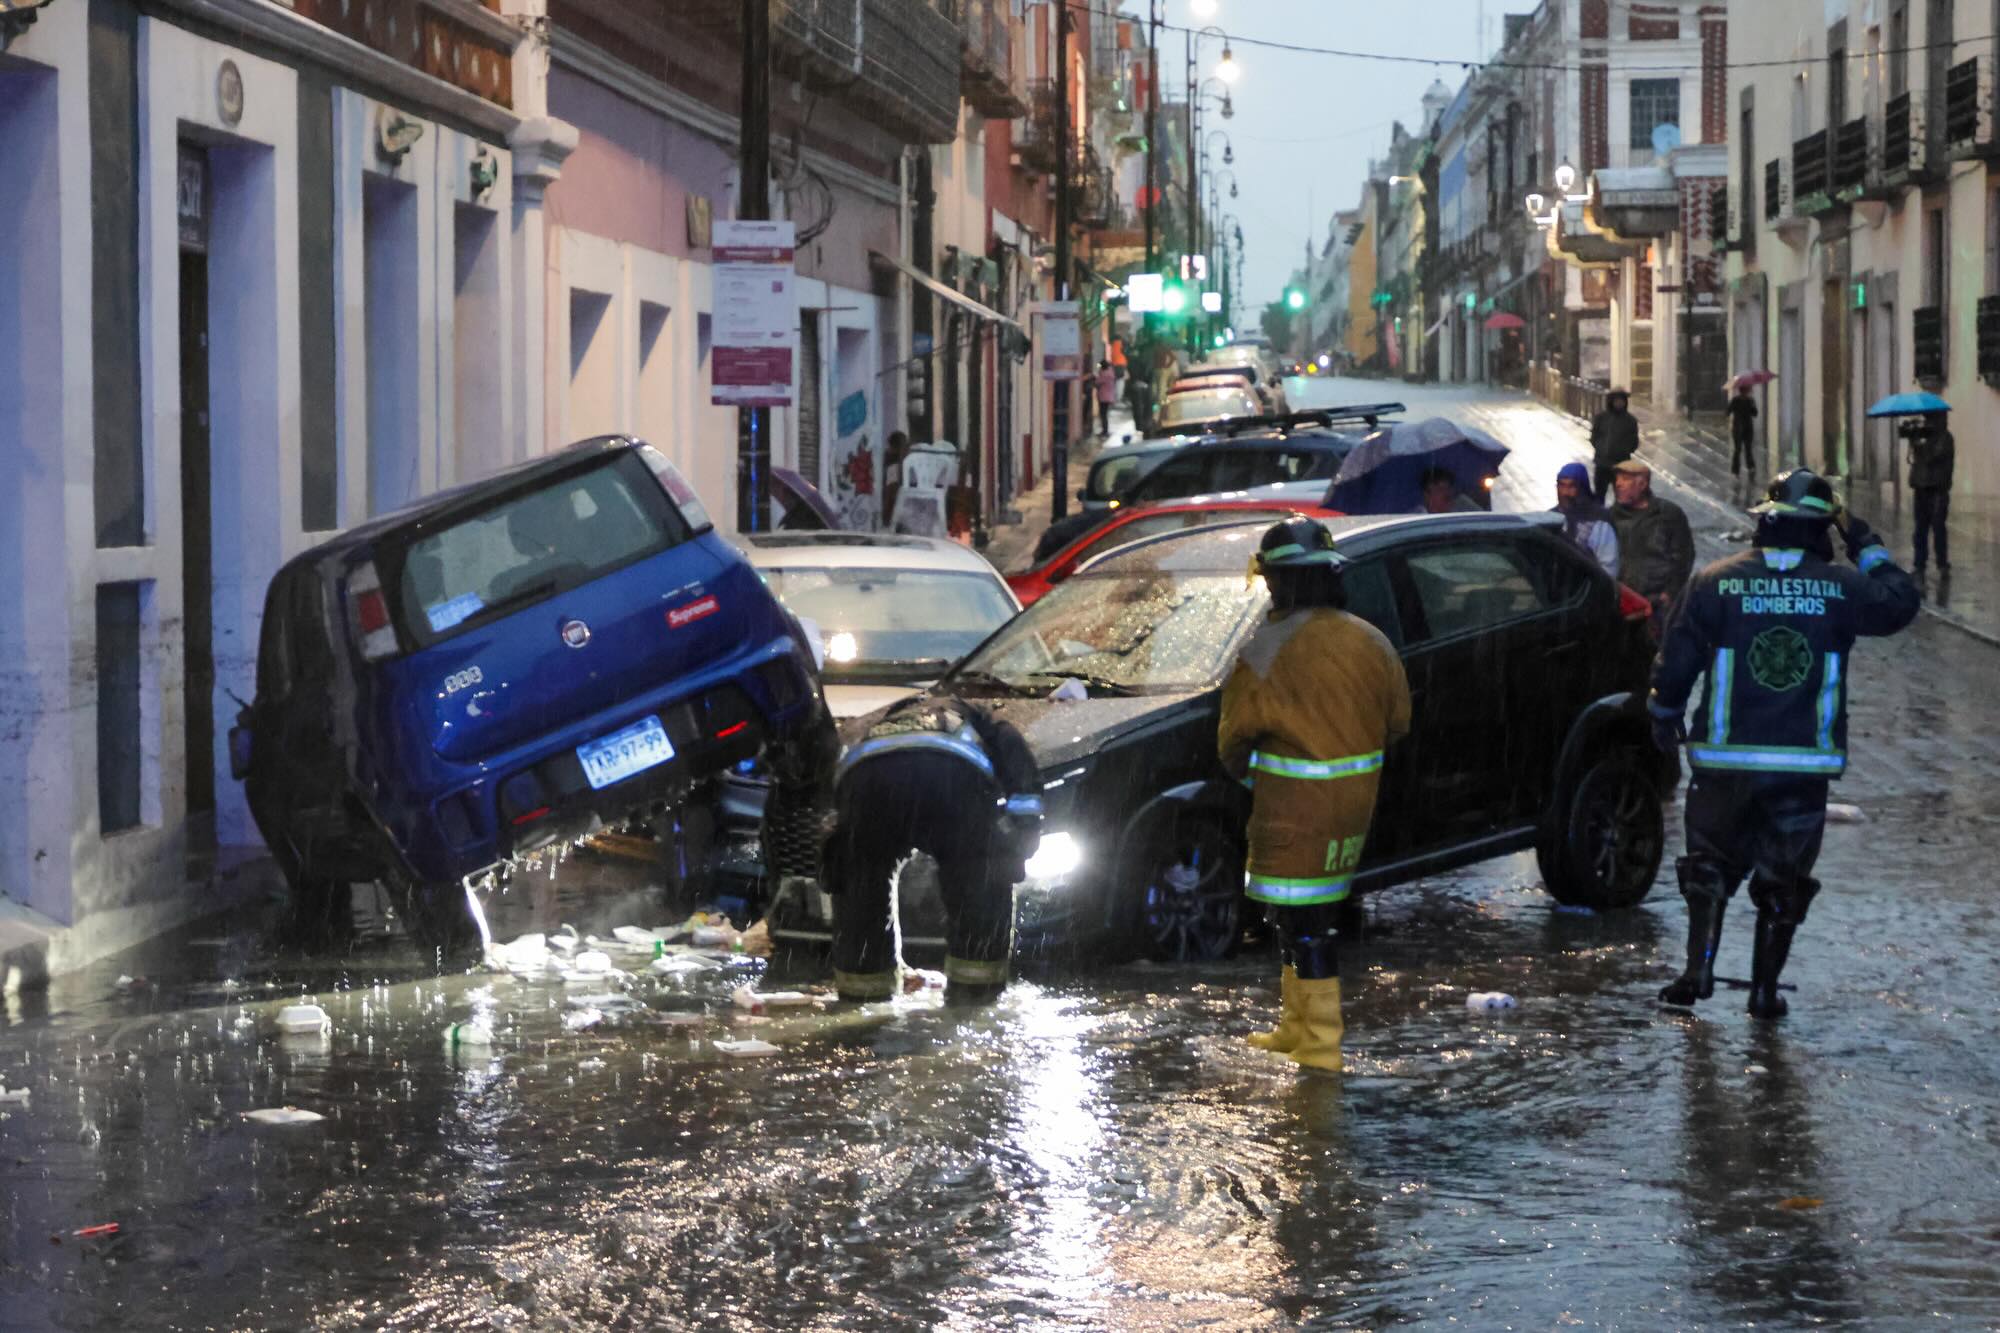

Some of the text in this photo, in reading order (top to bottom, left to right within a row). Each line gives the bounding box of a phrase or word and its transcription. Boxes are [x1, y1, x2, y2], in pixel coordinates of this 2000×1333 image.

[1718, 578, 1845, 600] POLICIA ESTATAL
[1741, 596, 1826, 615] BOMBEROS
